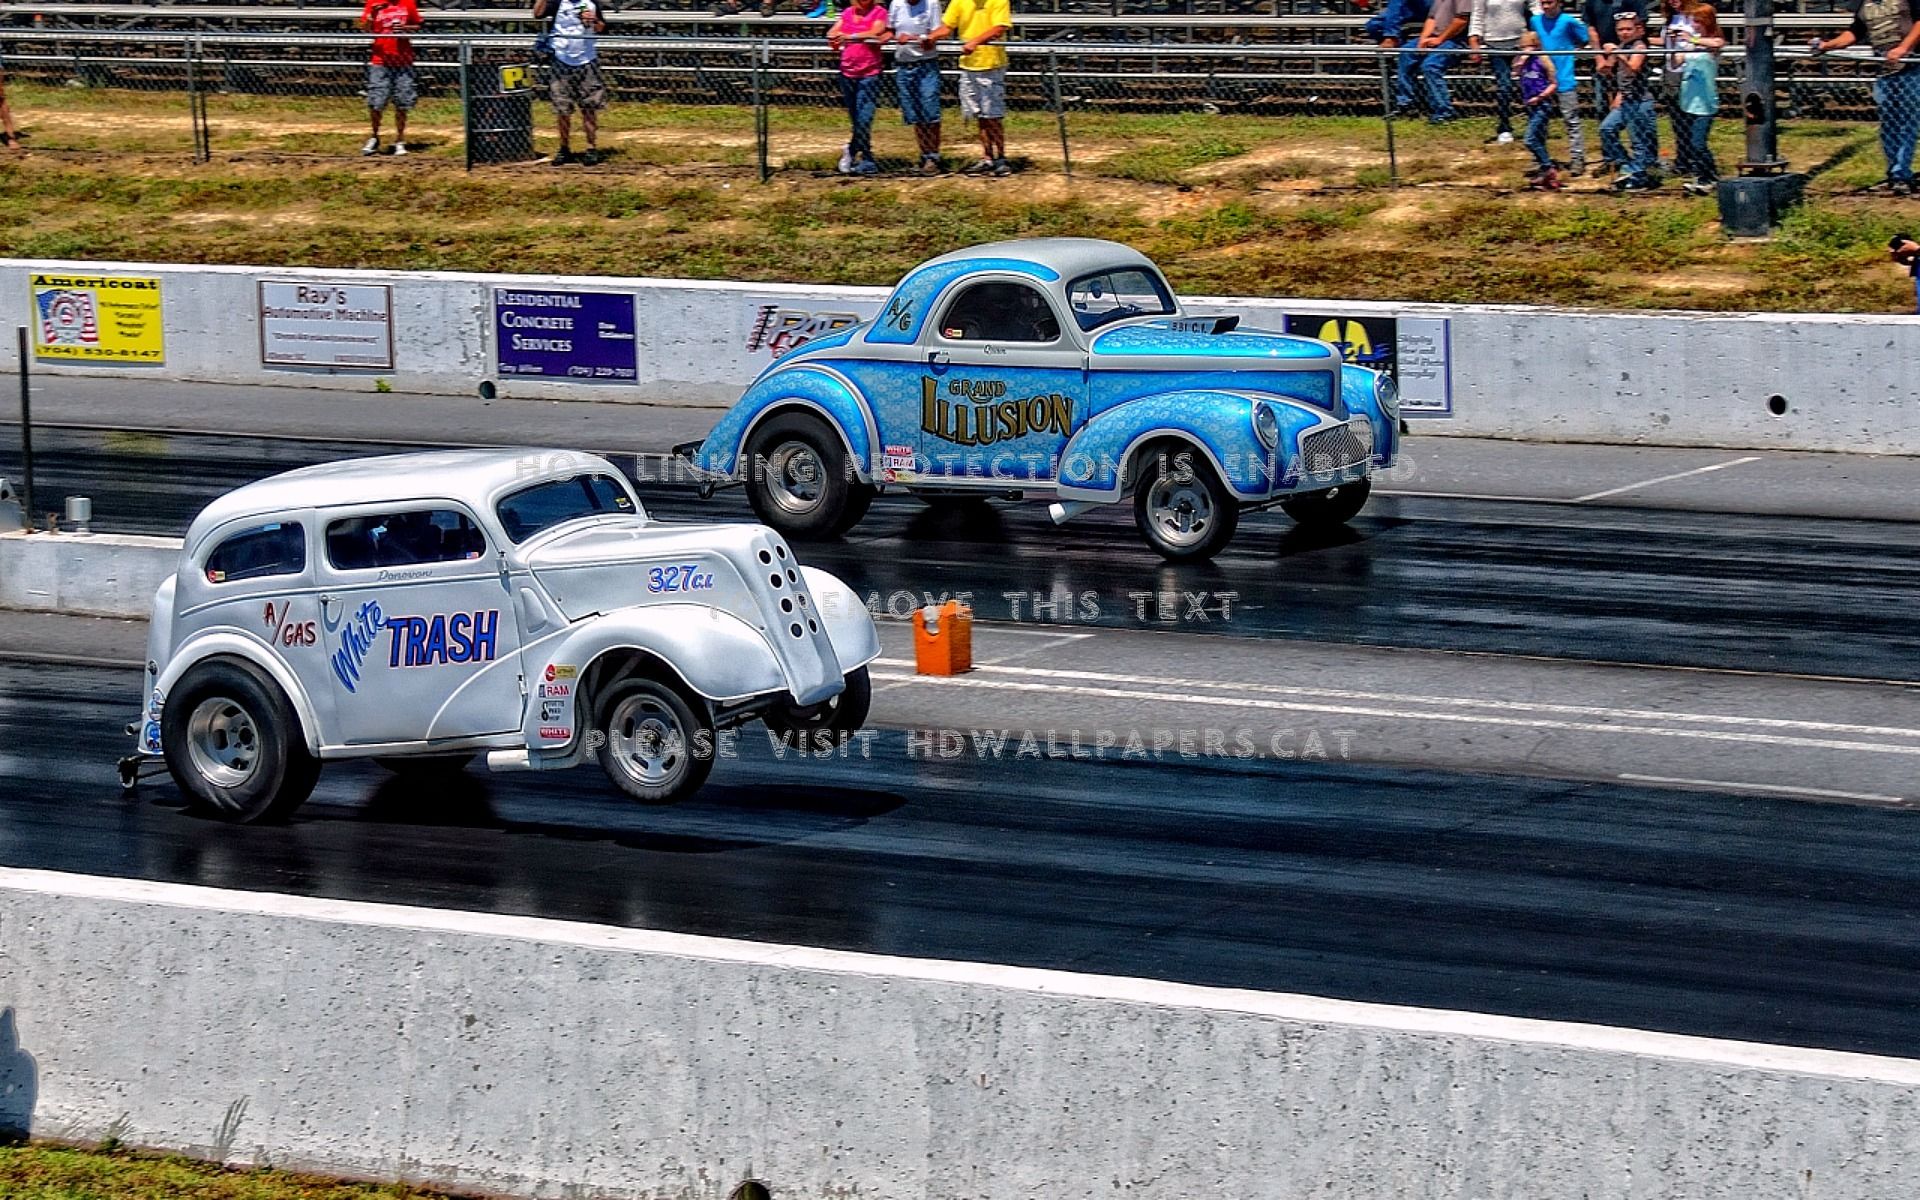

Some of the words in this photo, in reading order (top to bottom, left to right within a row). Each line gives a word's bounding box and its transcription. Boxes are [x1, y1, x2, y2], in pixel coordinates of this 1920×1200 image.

[33, 275, 158, 289] Americoat
[297, 286, 347, 304] Ray's
[263, 306, 333, 320] Automotive
[335, 308, 387, 321] Machine
[500, 311, 575, 329] CONCRETE
[511, 333, 573, 352] SERVICES
[949, 380, 1006, 403] GRAND
[921, 375, 1073, 446] ILLUSION
[330, 600, 392, 693] White
[386, 610, 499, 668] TRASH
[546, 685, 570, 696] RAM
